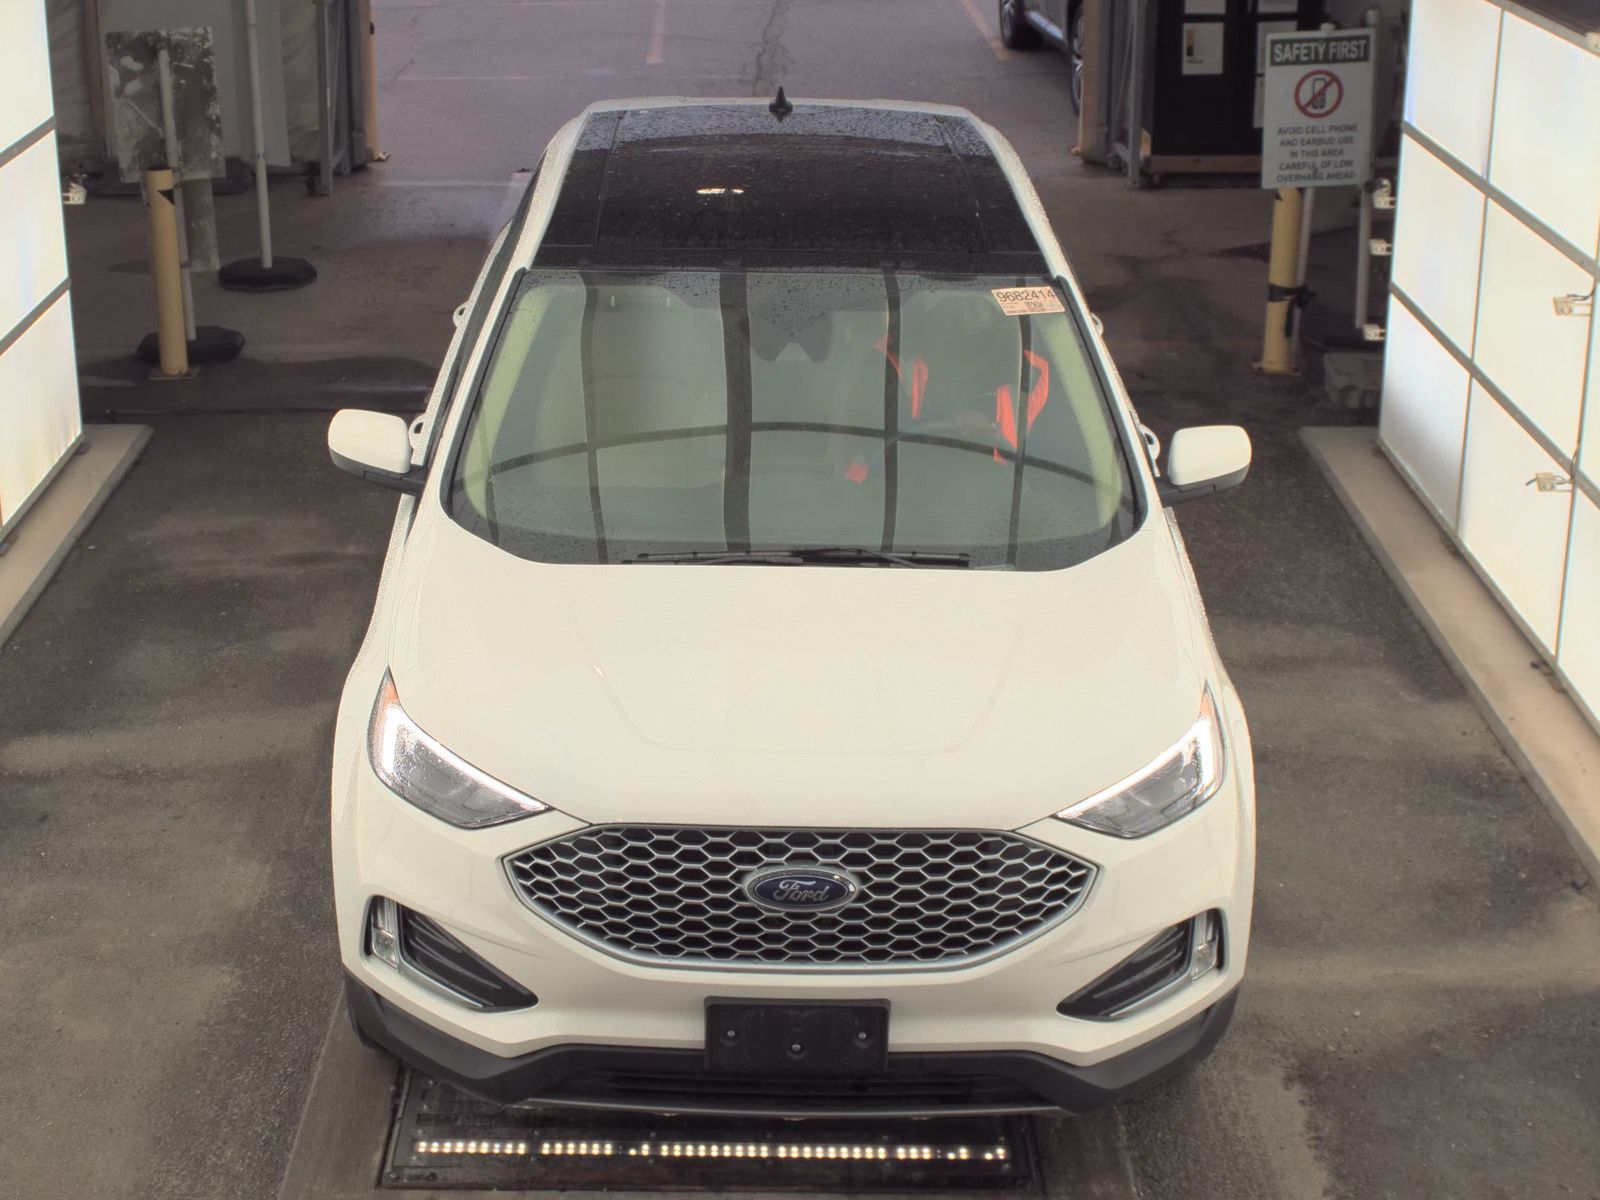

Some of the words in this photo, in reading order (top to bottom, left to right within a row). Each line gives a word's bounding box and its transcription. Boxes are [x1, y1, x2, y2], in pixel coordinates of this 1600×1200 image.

[1273, 42, 1326, 62] SAFETY
[1328, 40, 1367, 59] FIRST
[1277, 126, 1303, 135] AVOID
[1305, 125, 1326, 134] CELL
[1329, 123, 1358, 133] PHONE
[1280, 138, 1298, 147] AND
[1300, 137, 1336, 146] EARBUD
[1338, 135, 1355, 145] USE
[1289, 150, 1298, 158] IN
[1301, 149, 1320, 158] THIS
[1321, 148, 1345, 156] AREA
[1279, 161, 1318, 171] CAREFUL
[1320, 160, 1331, 169] OF
[1334, 159, 1354, 168] LOW
[1326, 170, 1356, 180] AHEAD
[996, 289, 1056, 302] 9682414
[773, 879, 830, 901] Ford
